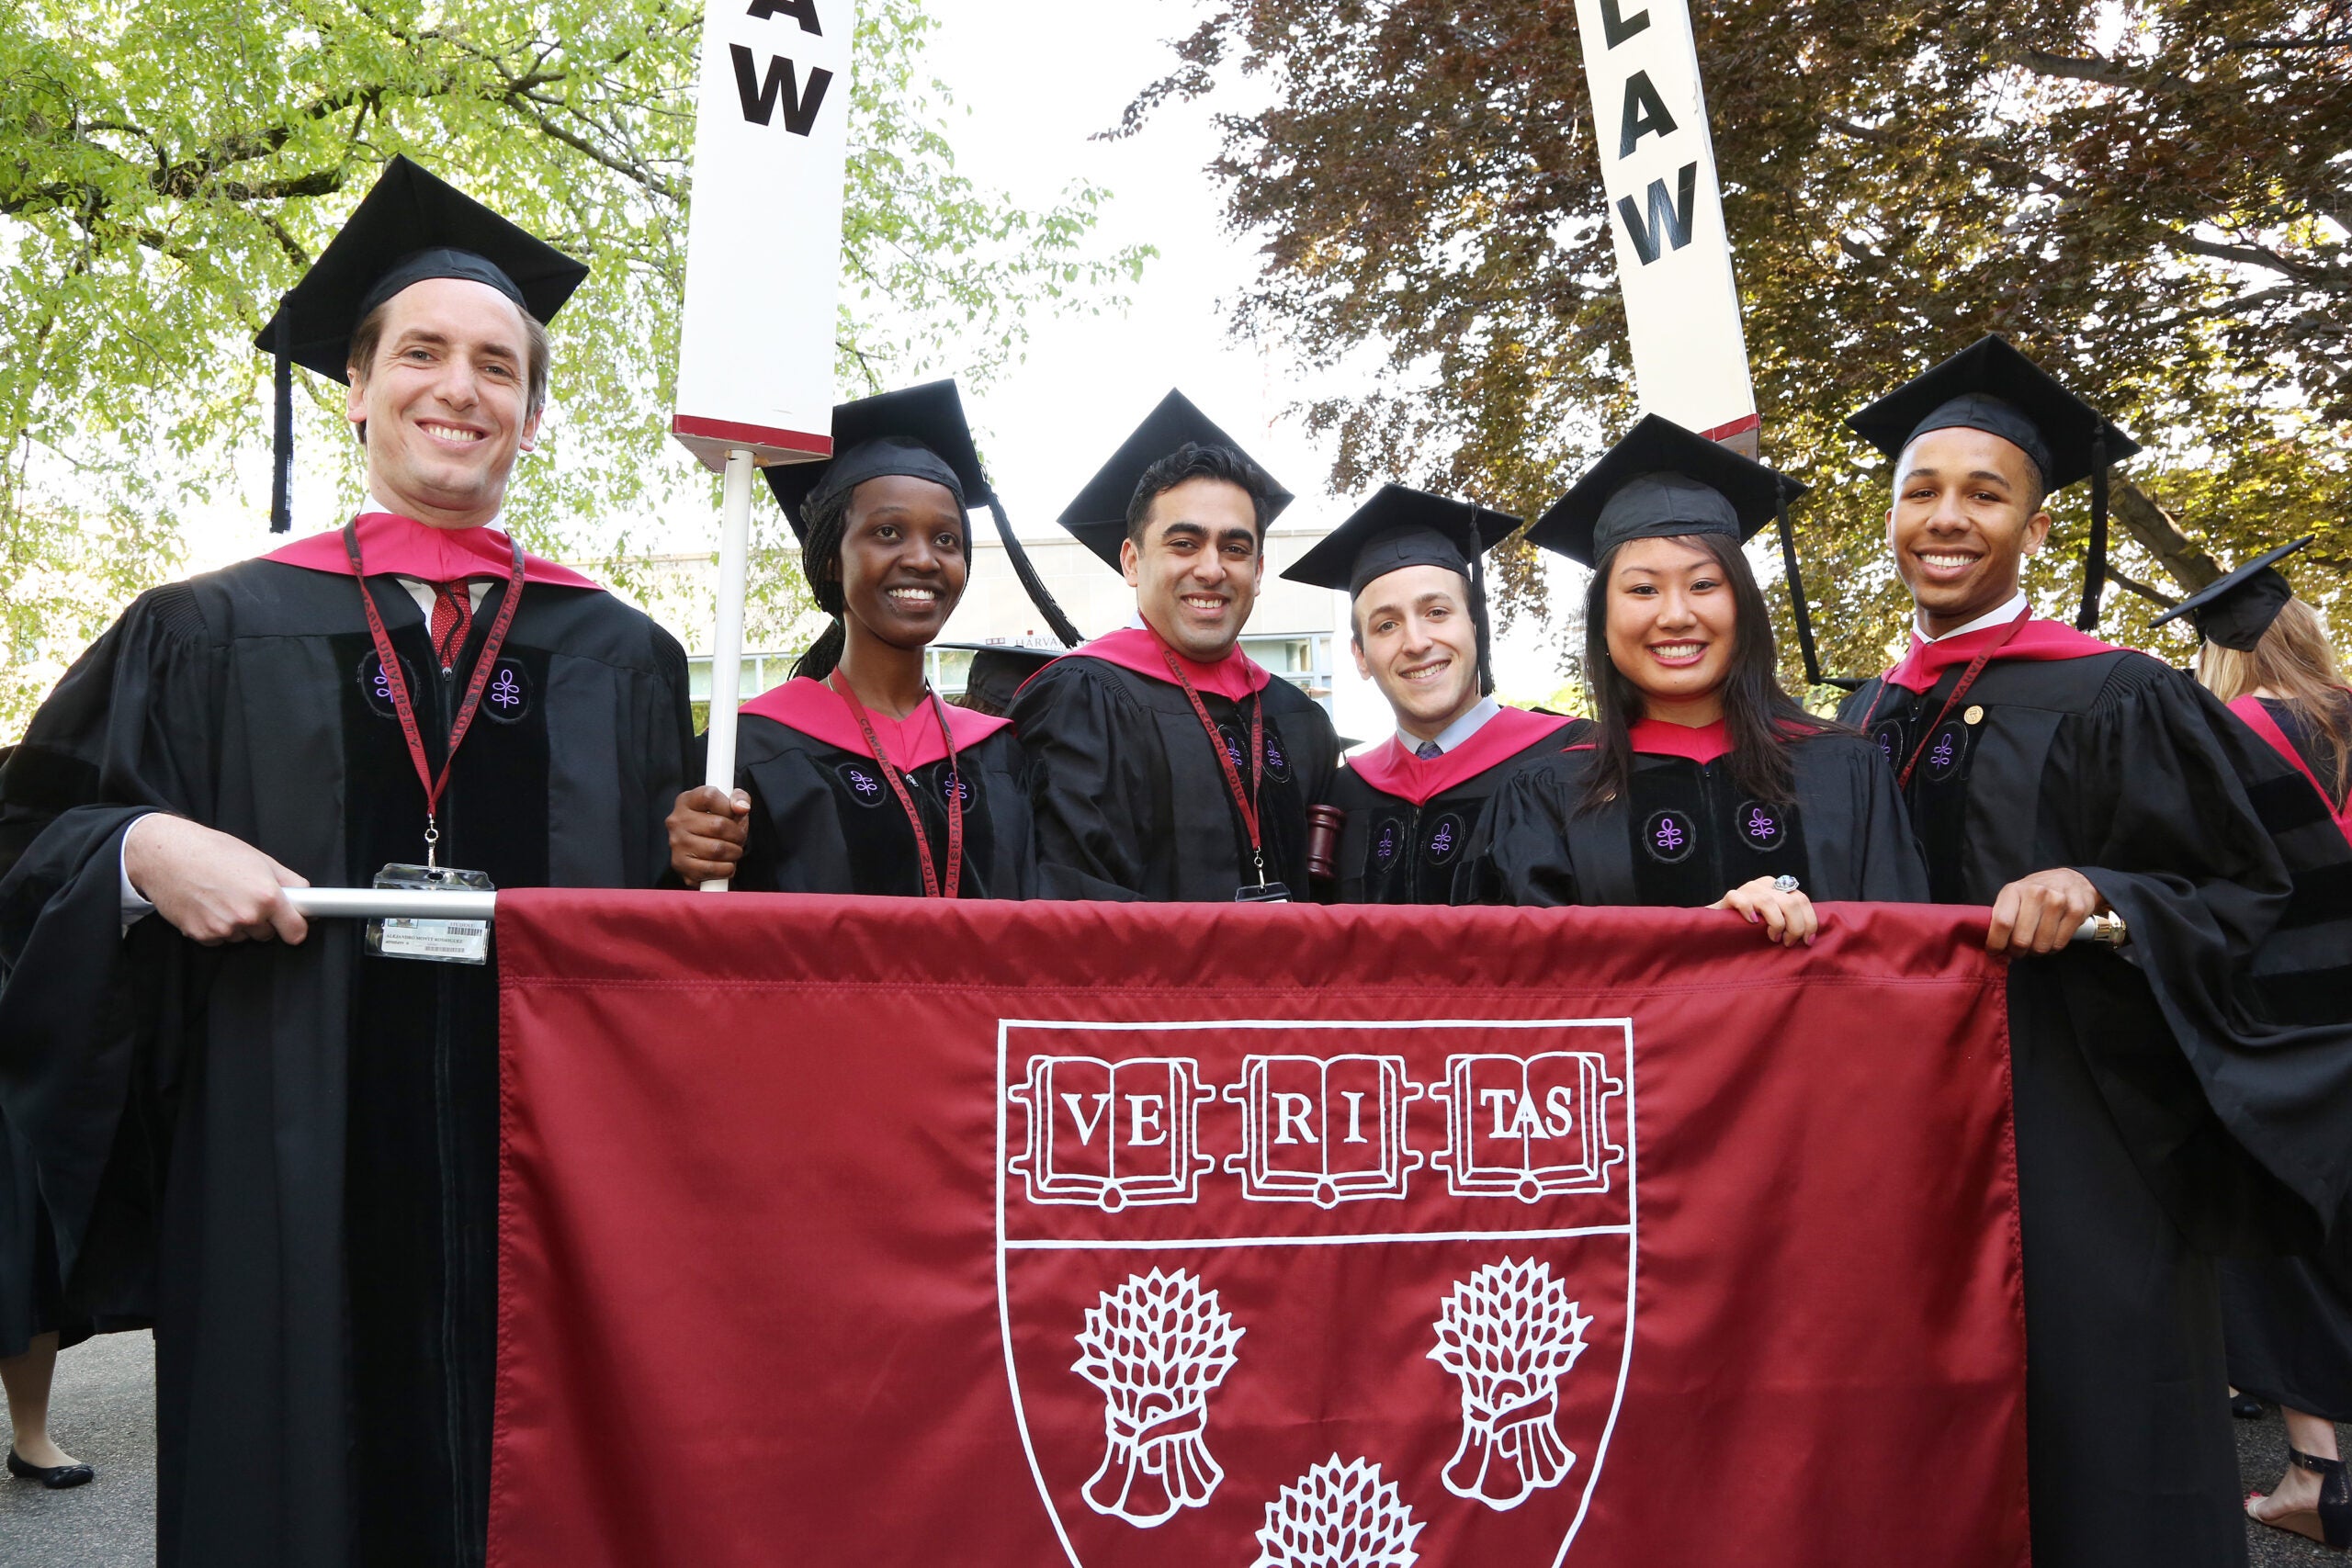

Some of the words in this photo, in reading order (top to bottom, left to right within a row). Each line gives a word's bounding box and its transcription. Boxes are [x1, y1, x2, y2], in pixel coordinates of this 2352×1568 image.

[1600, 0, 1697, 265] LAW
[378, 640, 421, 749] UNIVERSITY
[1164, 650, 1227, 757] COMMENCEMENT
[1225, 766, 1243, 800] 2014
[859, 717, 926, 842] COMMENCEMENT
[947, 795, 961, 892] UNIVERSITY
[1060, 1092, 1168, 1146] VE
[1272, 1090, 1368, 1145] RI
[1480, 1084, 1573, 1140] TAS
